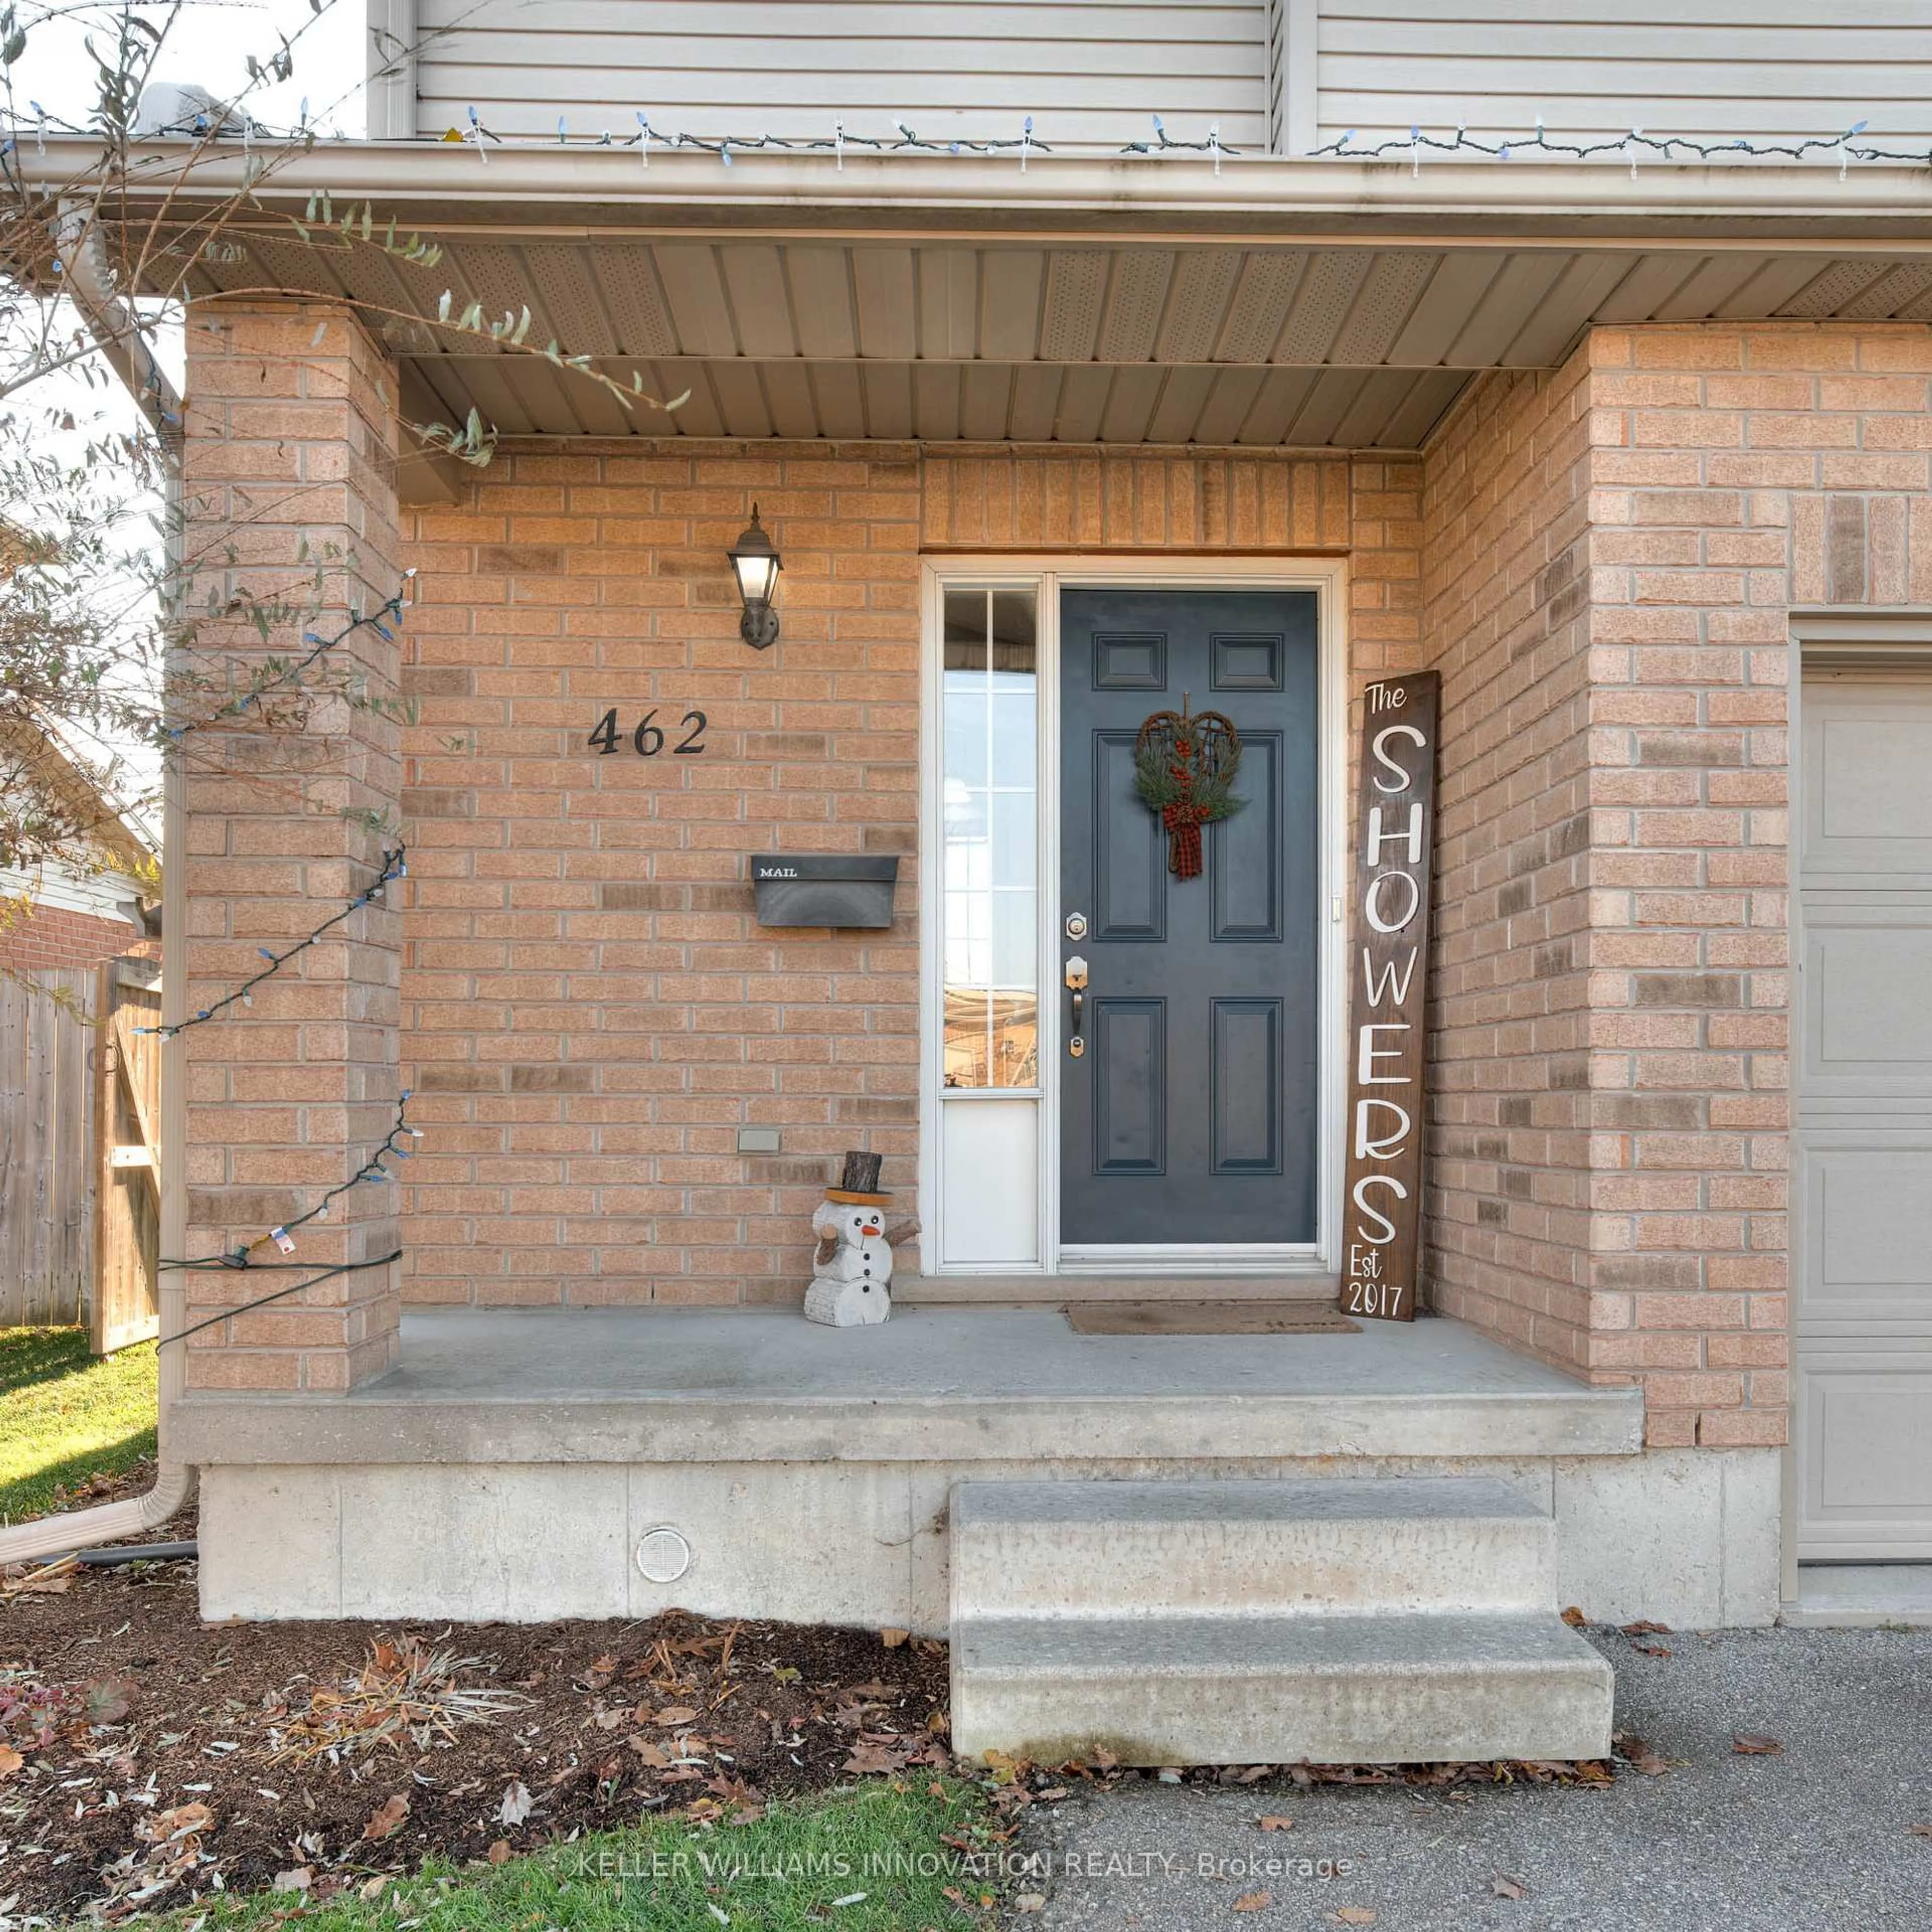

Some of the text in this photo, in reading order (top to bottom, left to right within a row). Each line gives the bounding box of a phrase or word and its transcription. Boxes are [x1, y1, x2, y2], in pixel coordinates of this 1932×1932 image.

[1364, 683, 1408, 714] The
[588, 707, 707, 756] 462
[759, 867, 798, 877] MAIL
[1353, 725, 1427, 1245] SHOWERS
[1350, 1244, 1383, 1278] Est
[1349, 1281, 1403, 1316] 2017
